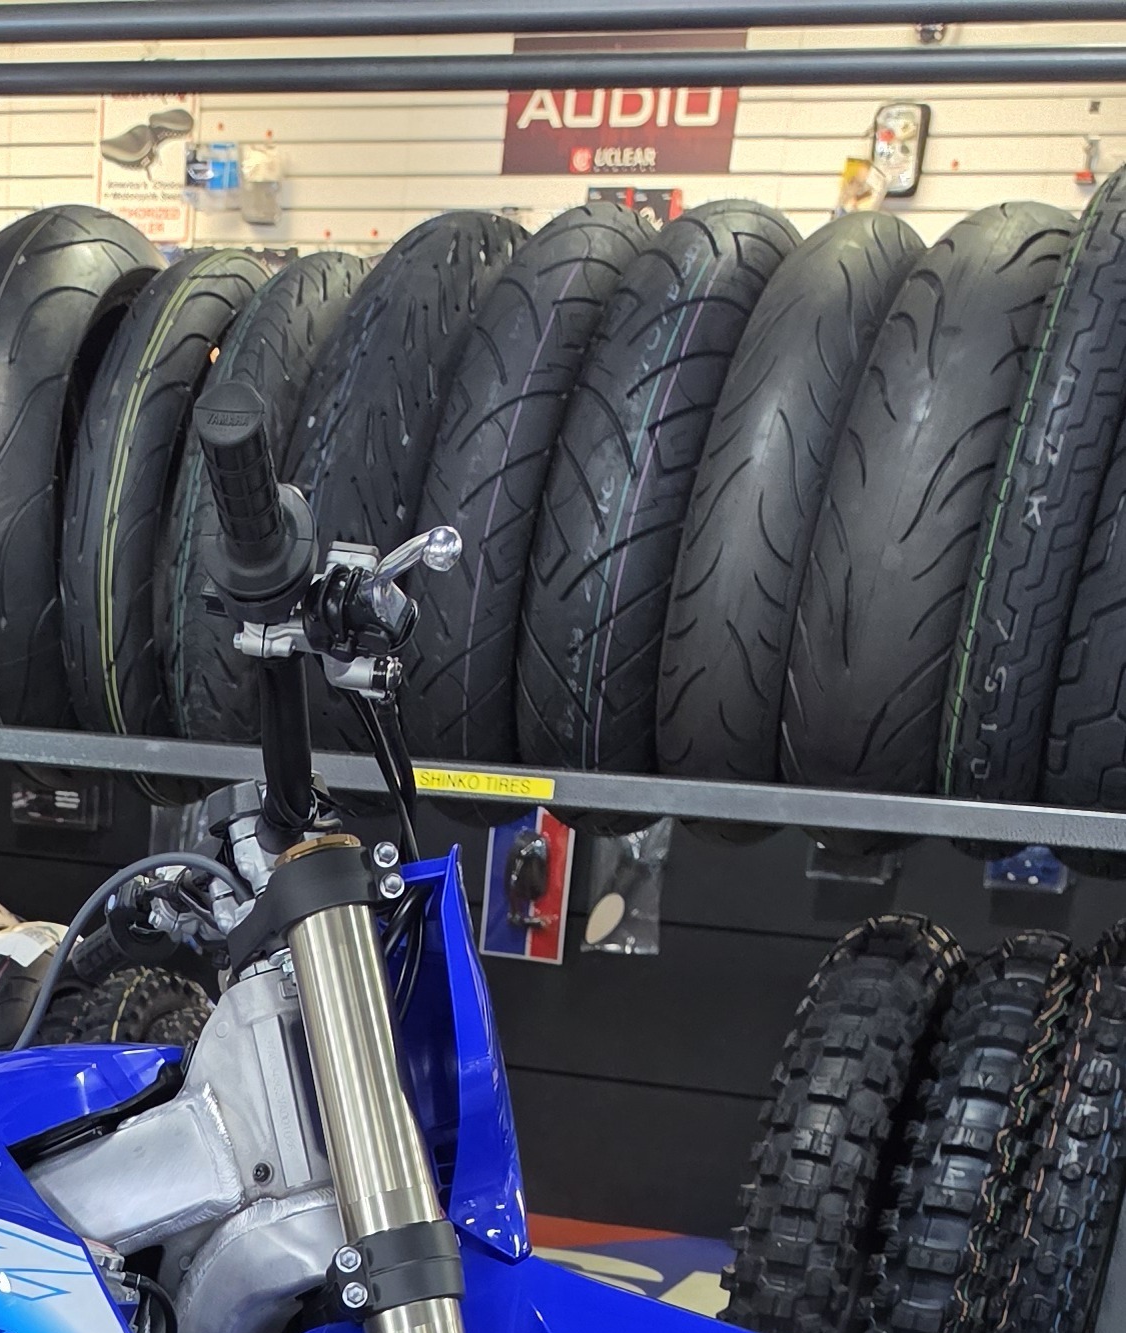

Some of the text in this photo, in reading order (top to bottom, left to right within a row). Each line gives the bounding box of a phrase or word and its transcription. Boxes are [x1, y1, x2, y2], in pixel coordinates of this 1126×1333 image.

[516, 87, 723, 129] AUDIO
[593, 147, 657, 167] UCLEAR
[419, 771, 531, 794] SHINKO TIRES
